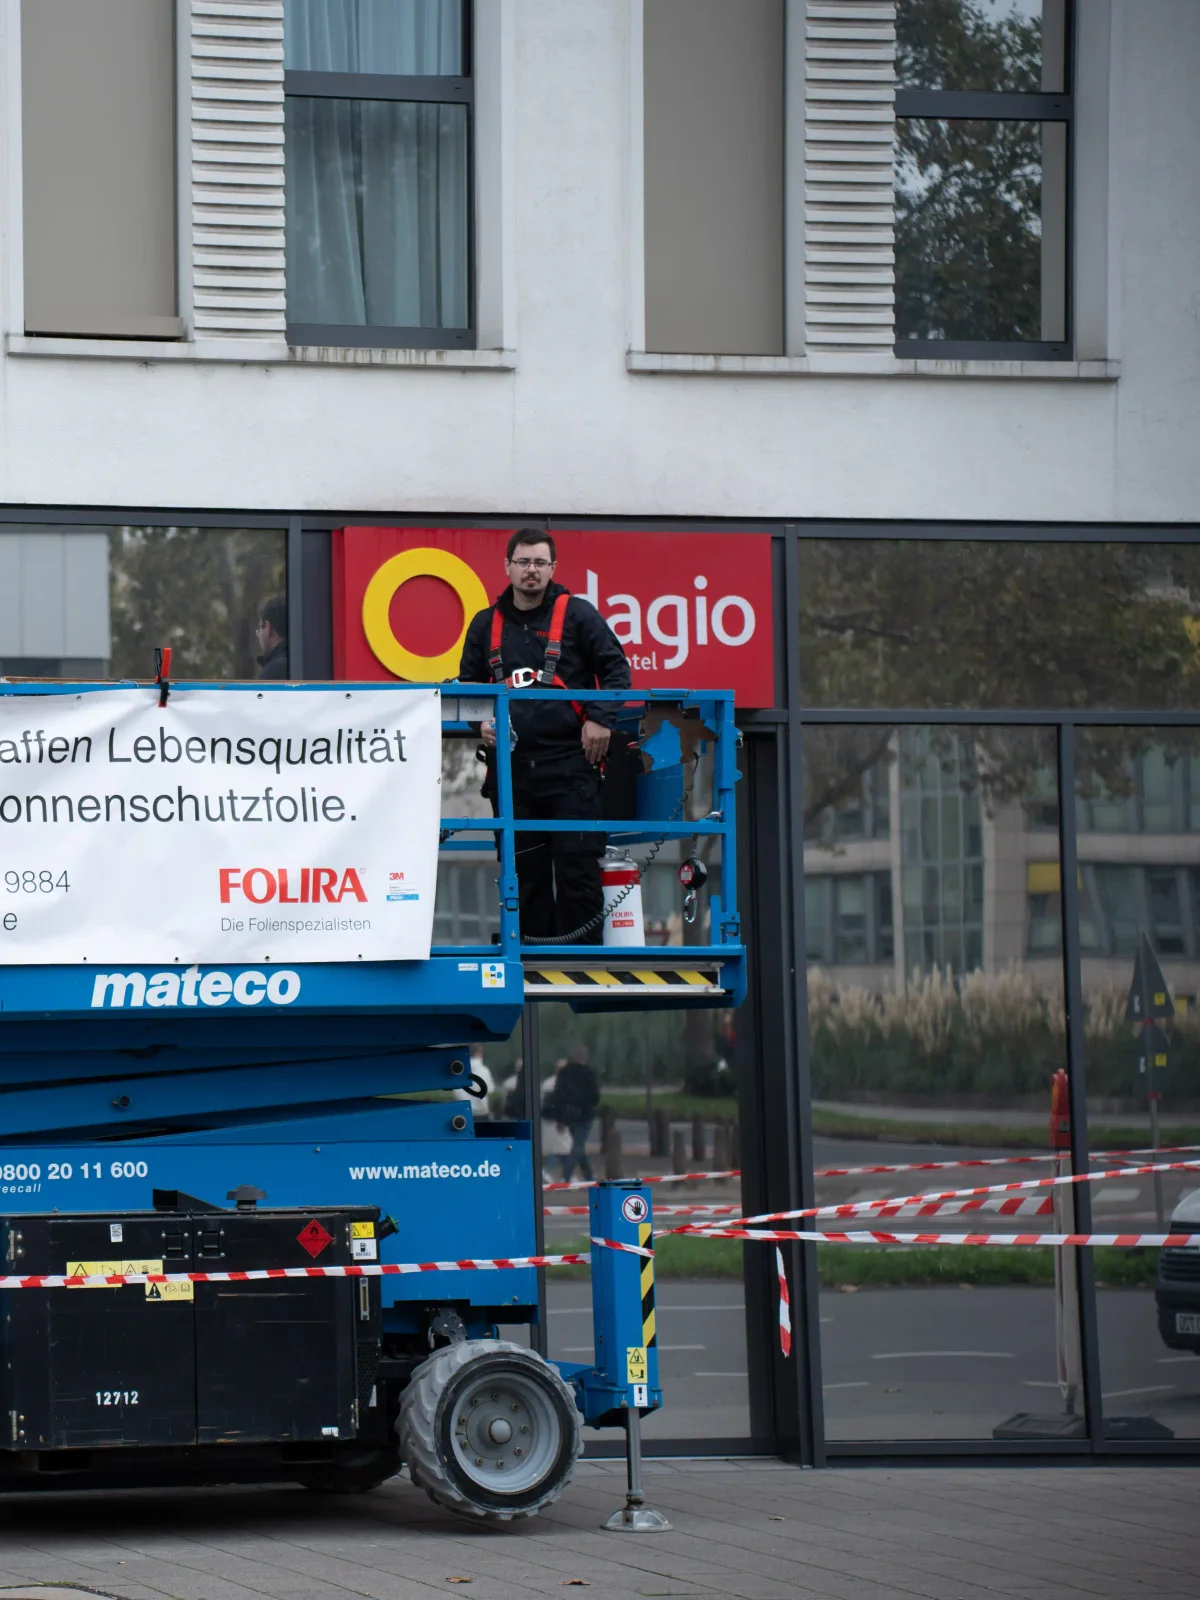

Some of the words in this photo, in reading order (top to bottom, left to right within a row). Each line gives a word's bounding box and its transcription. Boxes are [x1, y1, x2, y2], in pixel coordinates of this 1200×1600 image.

[108, 726, 408, 774] Lebensqualität
[4, 869, 71, 894] 9884
[219, 867, 368, 904] FOLIRA
[389, 872, 404, 880] 3M
[221, 917, 244, 932] Die
[249, 917, 371, 934] Folienspezialisten
[90, 967, 301, 1008] mateco
[47, 1162, 73, 1180] 20
[80, 1162, 102, 1179] 11
[110, 1161, 149, 1179] 600
[348, 1159, 501, 1181] www.mateco.de
[95, 1390, 139, 1406] 12712
